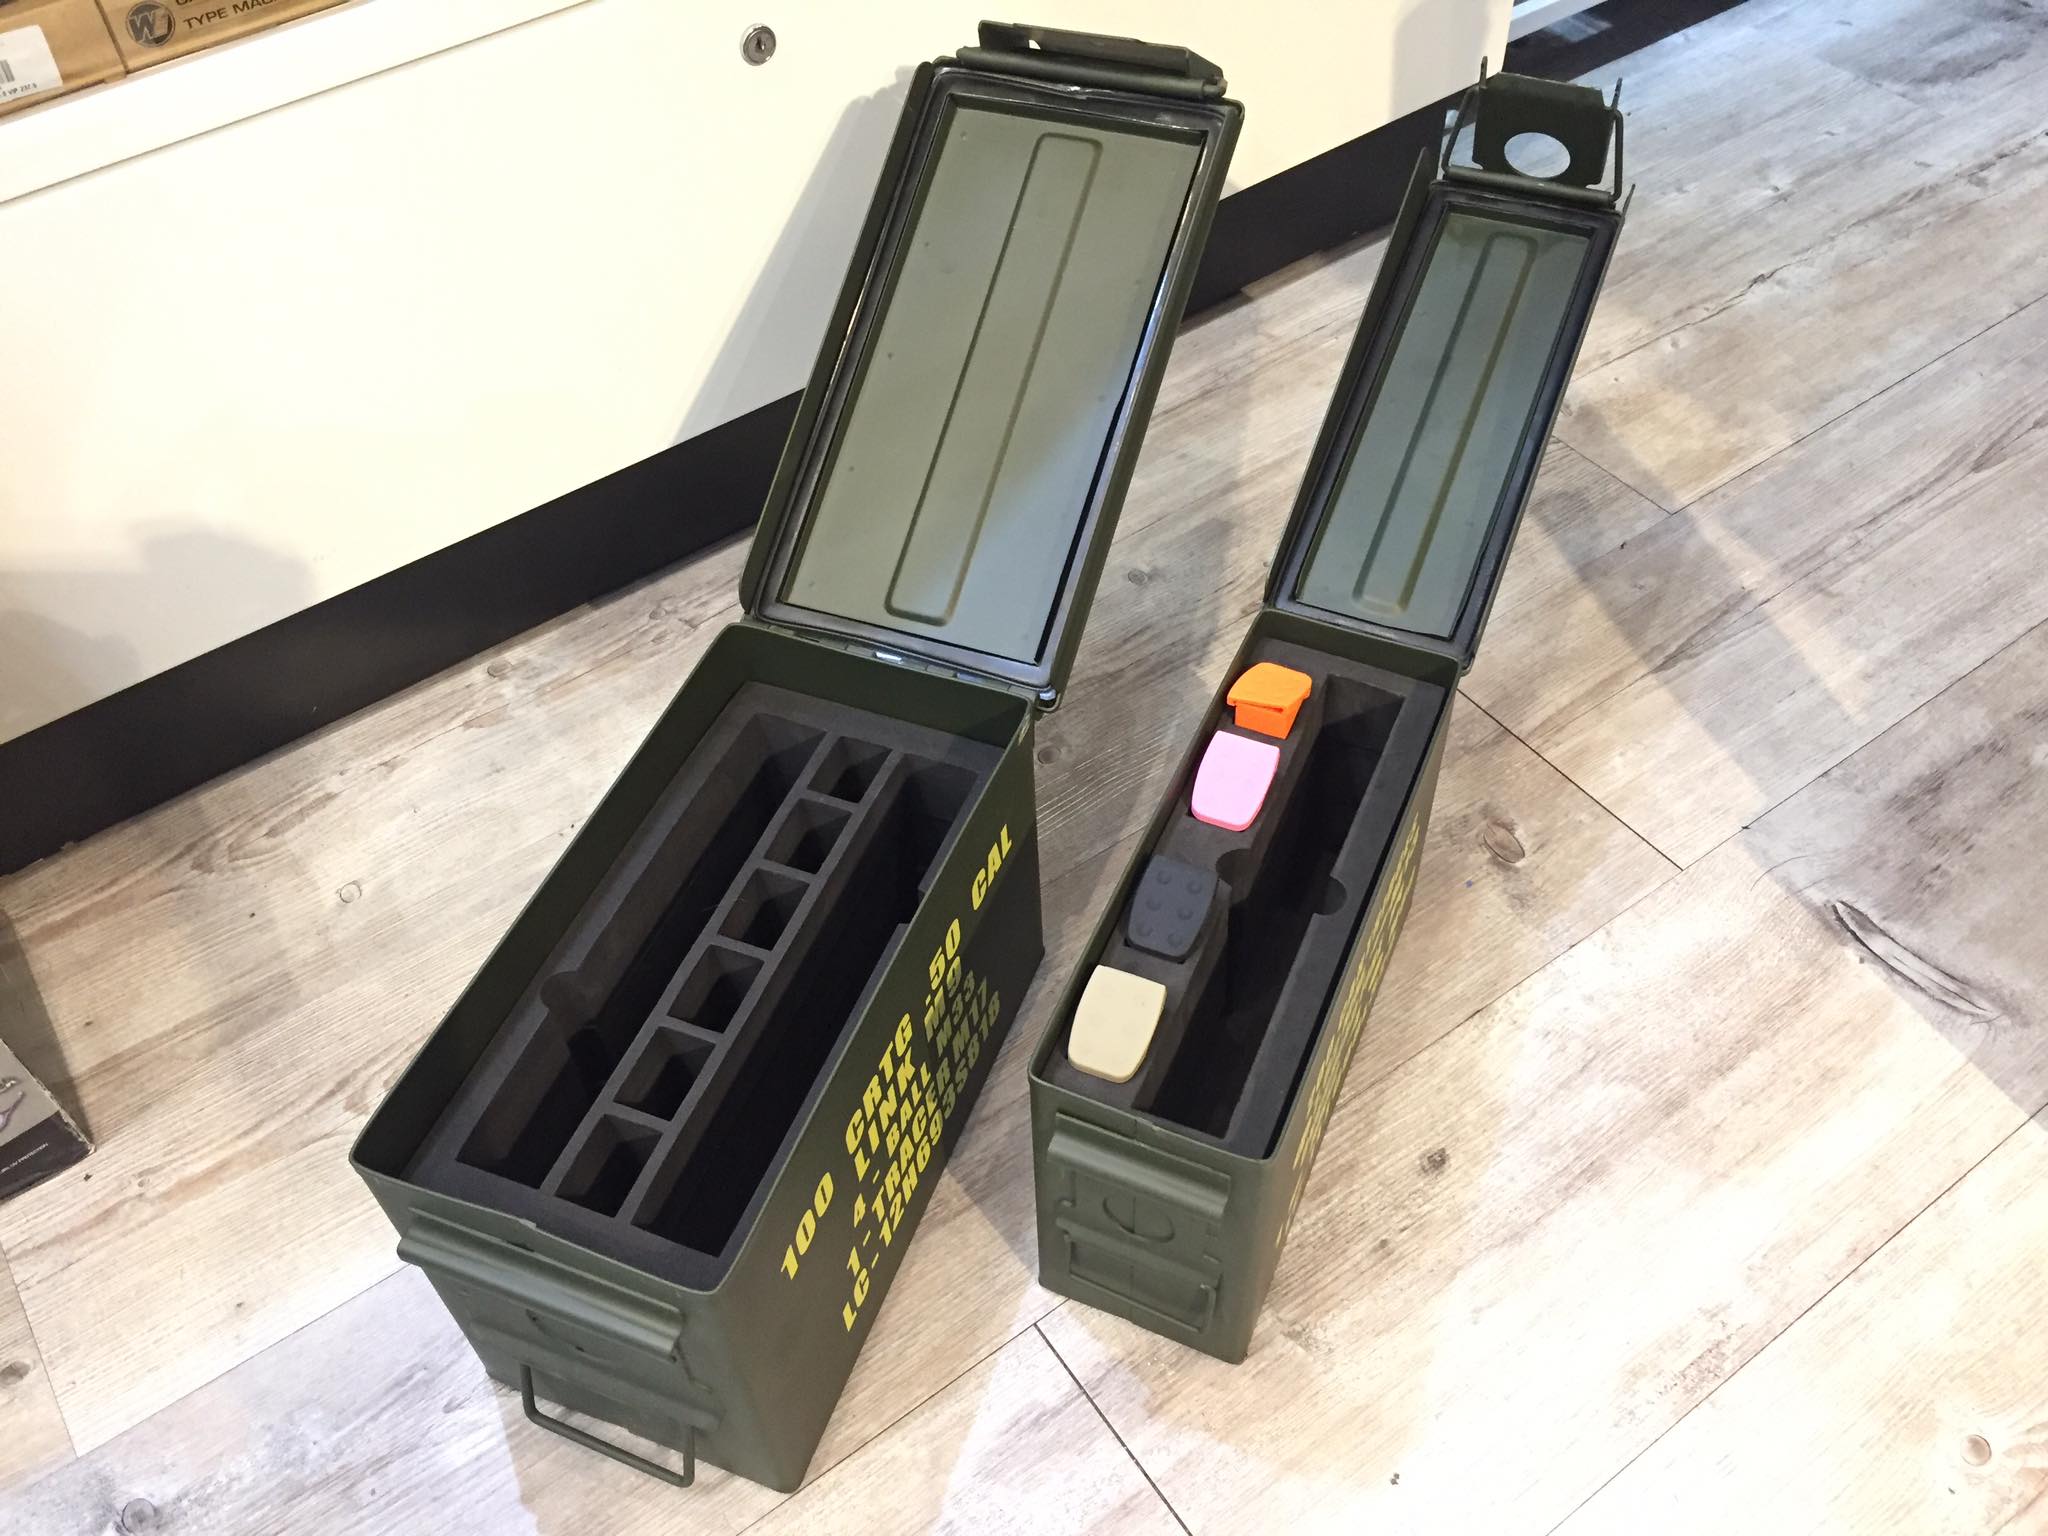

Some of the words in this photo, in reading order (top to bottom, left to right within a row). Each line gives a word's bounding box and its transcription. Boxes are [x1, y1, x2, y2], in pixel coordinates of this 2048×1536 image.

[183, 7, 229, 30] TYPE
[780, 1171, 835, 1280] 100
[844, 1013, 913, 1155] CRTG
[925, 917, 961, 1006] .50
[971, 824, 1012, 910] CAL
[852, 1192, 868, 1229] 4
[885, 1061, 932, 1159] BALL
[936, 969, 976, 1058] M33
[854, 1046, 916, 1185] LINK
[924, 955, 962, 1043] M9
[952, 975, 988, 1065] M17
